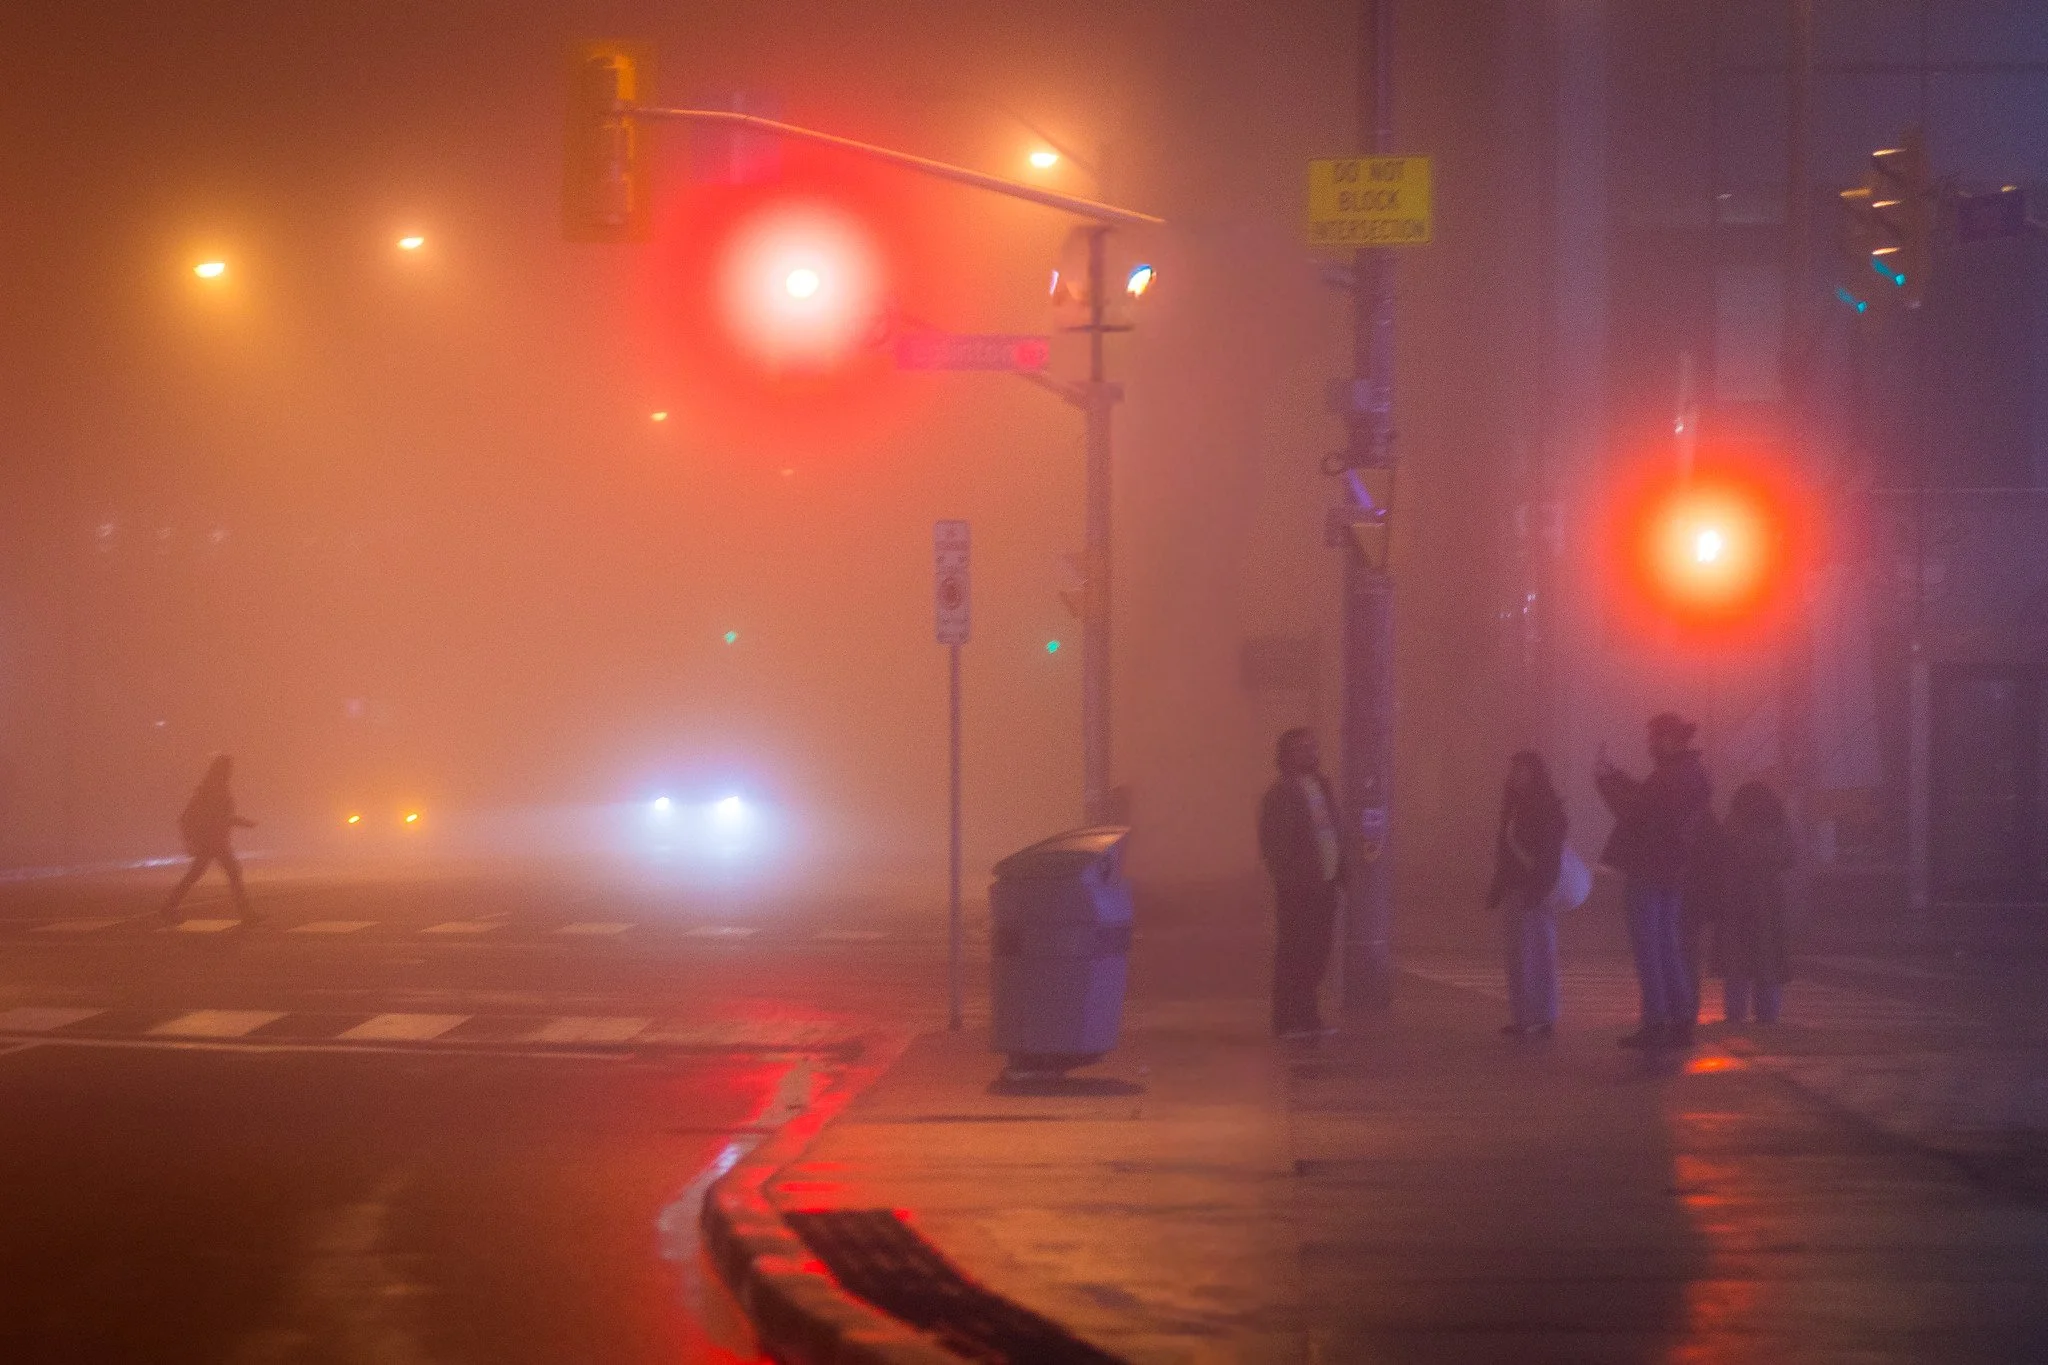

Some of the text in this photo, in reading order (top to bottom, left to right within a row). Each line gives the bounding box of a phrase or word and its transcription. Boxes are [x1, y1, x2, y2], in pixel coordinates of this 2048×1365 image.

[1333, 160, 1405, 183] DO NOT
[1338, 189, 1400, 212] BLOCK
[1313, 219, 1426, 240] INTERSECTION
